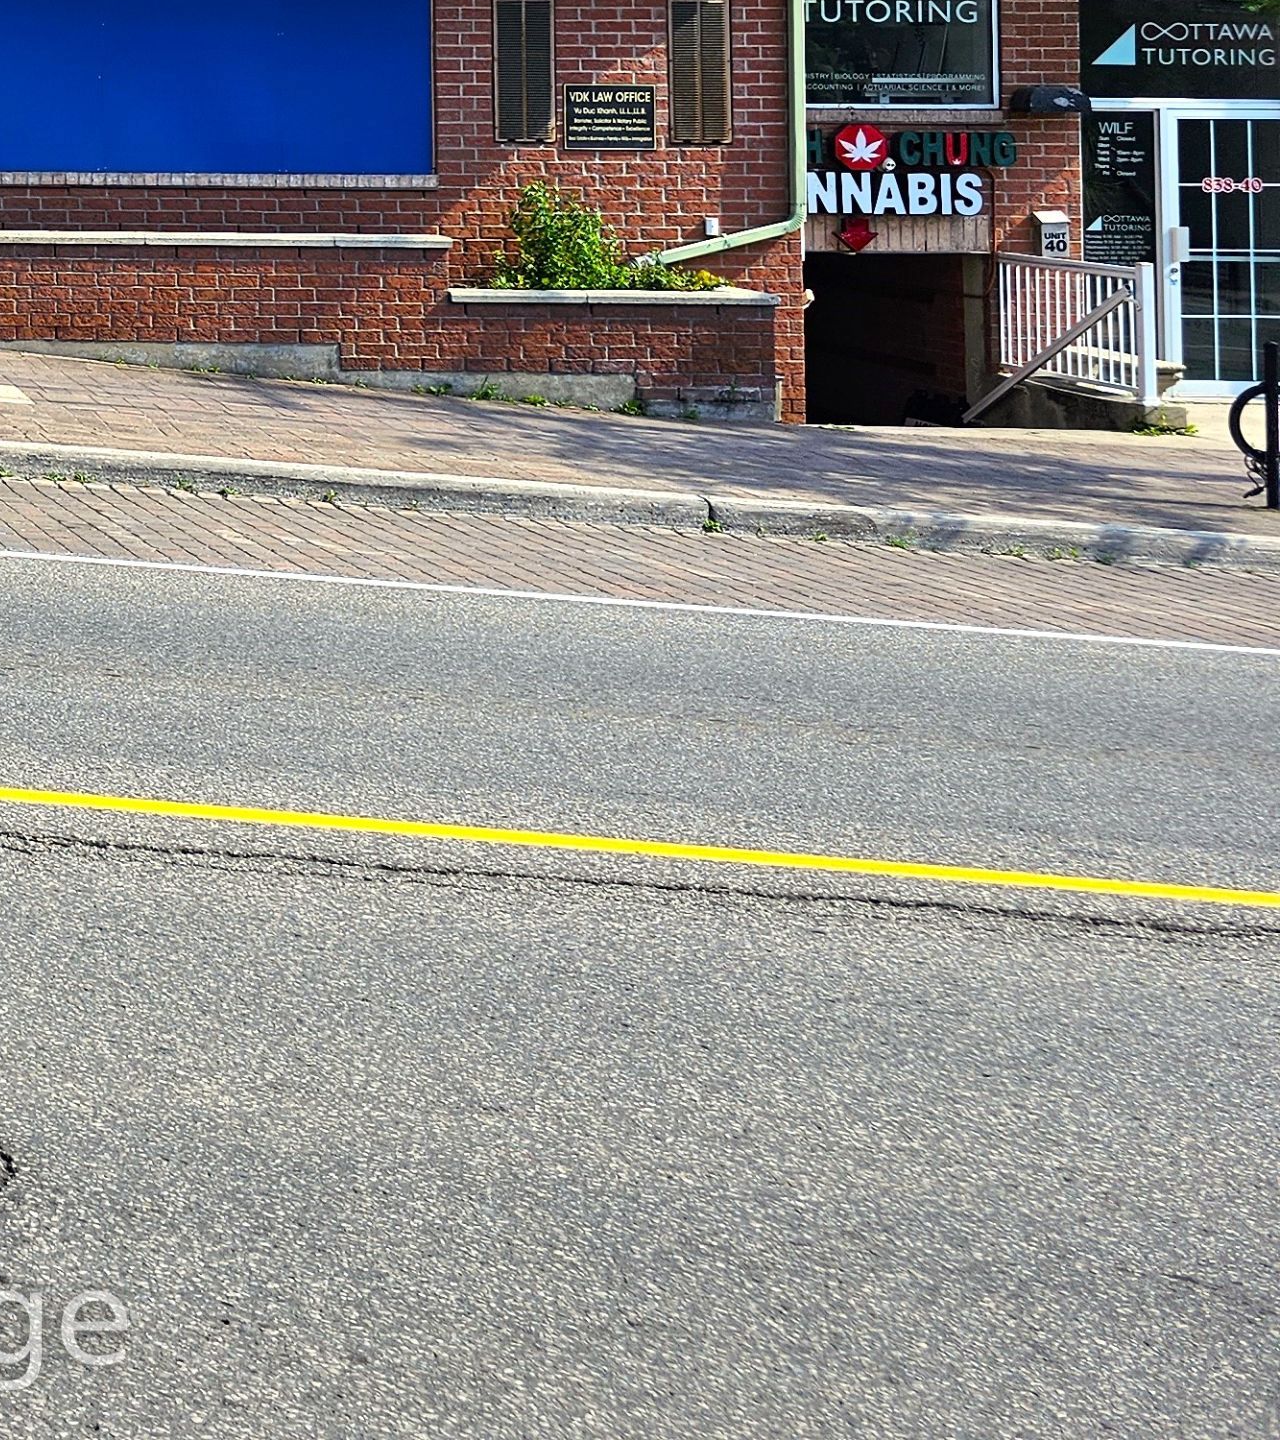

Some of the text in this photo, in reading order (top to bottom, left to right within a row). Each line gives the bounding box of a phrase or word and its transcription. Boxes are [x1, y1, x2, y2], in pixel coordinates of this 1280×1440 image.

[804, 0, 978, 23] TUTORING
[1141, 47, 1276, 66] TUTORING
[568, 91, 651, 103] VDK LAW OFFICE
[1098, 121, 1134, 135] WILF
[899, 130, 1017, 167] CHUNG
[1201, 177, 1263, 194] 838-40
[807, 171, 984, 217] NNABIS
[1103, 224, 1152, 232] TUTORING
[1044, 232, 1067, 240] UNIT
[1044, 240, 1068, 253] 40
